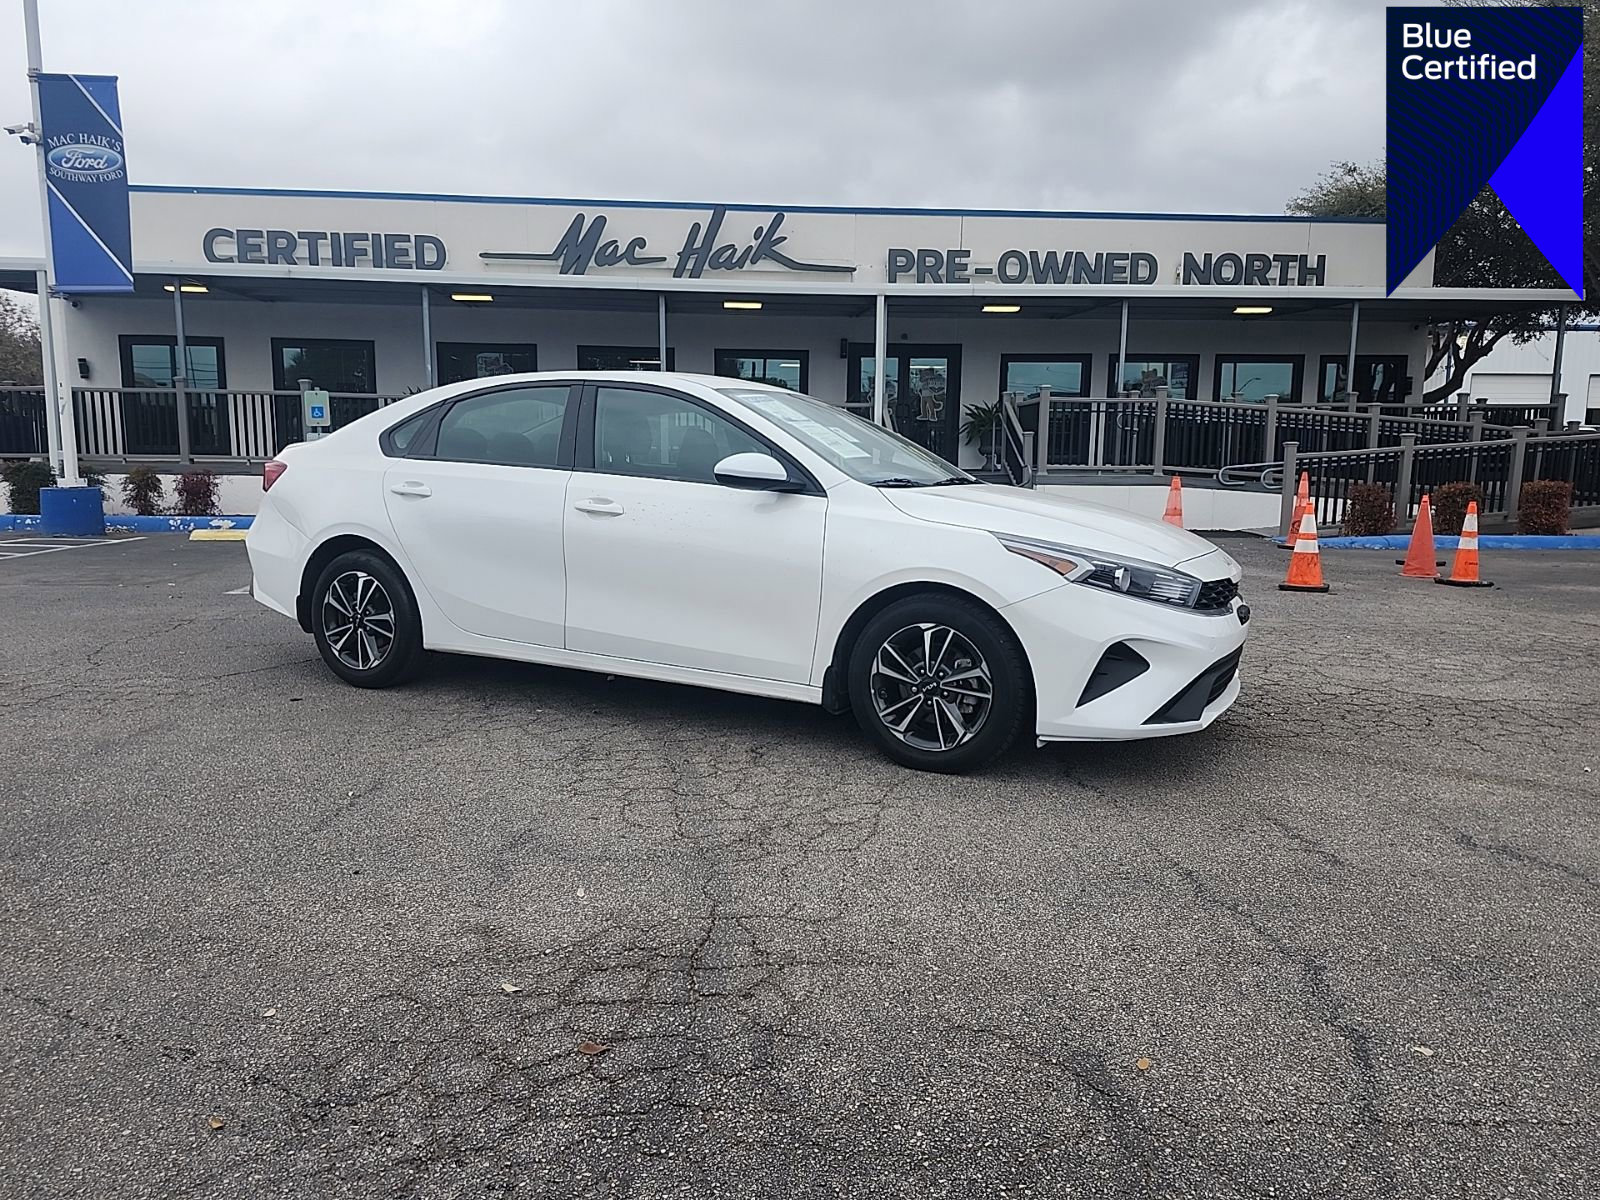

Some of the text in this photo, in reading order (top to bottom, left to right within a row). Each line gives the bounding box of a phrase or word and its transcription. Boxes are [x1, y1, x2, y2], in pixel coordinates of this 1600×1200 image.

[47, 133, 122, 152] MAC HAIK'S
[61, 148, 108, 169] Ford
[49, 167, 124, 183] SOUTHWAY FORD
[202, 227, 447, 271] CERTIFIED
[479, 205, 857, 278] Mac Haik
[887, 248, 1326, 287] PRE-OWNED NORTH
